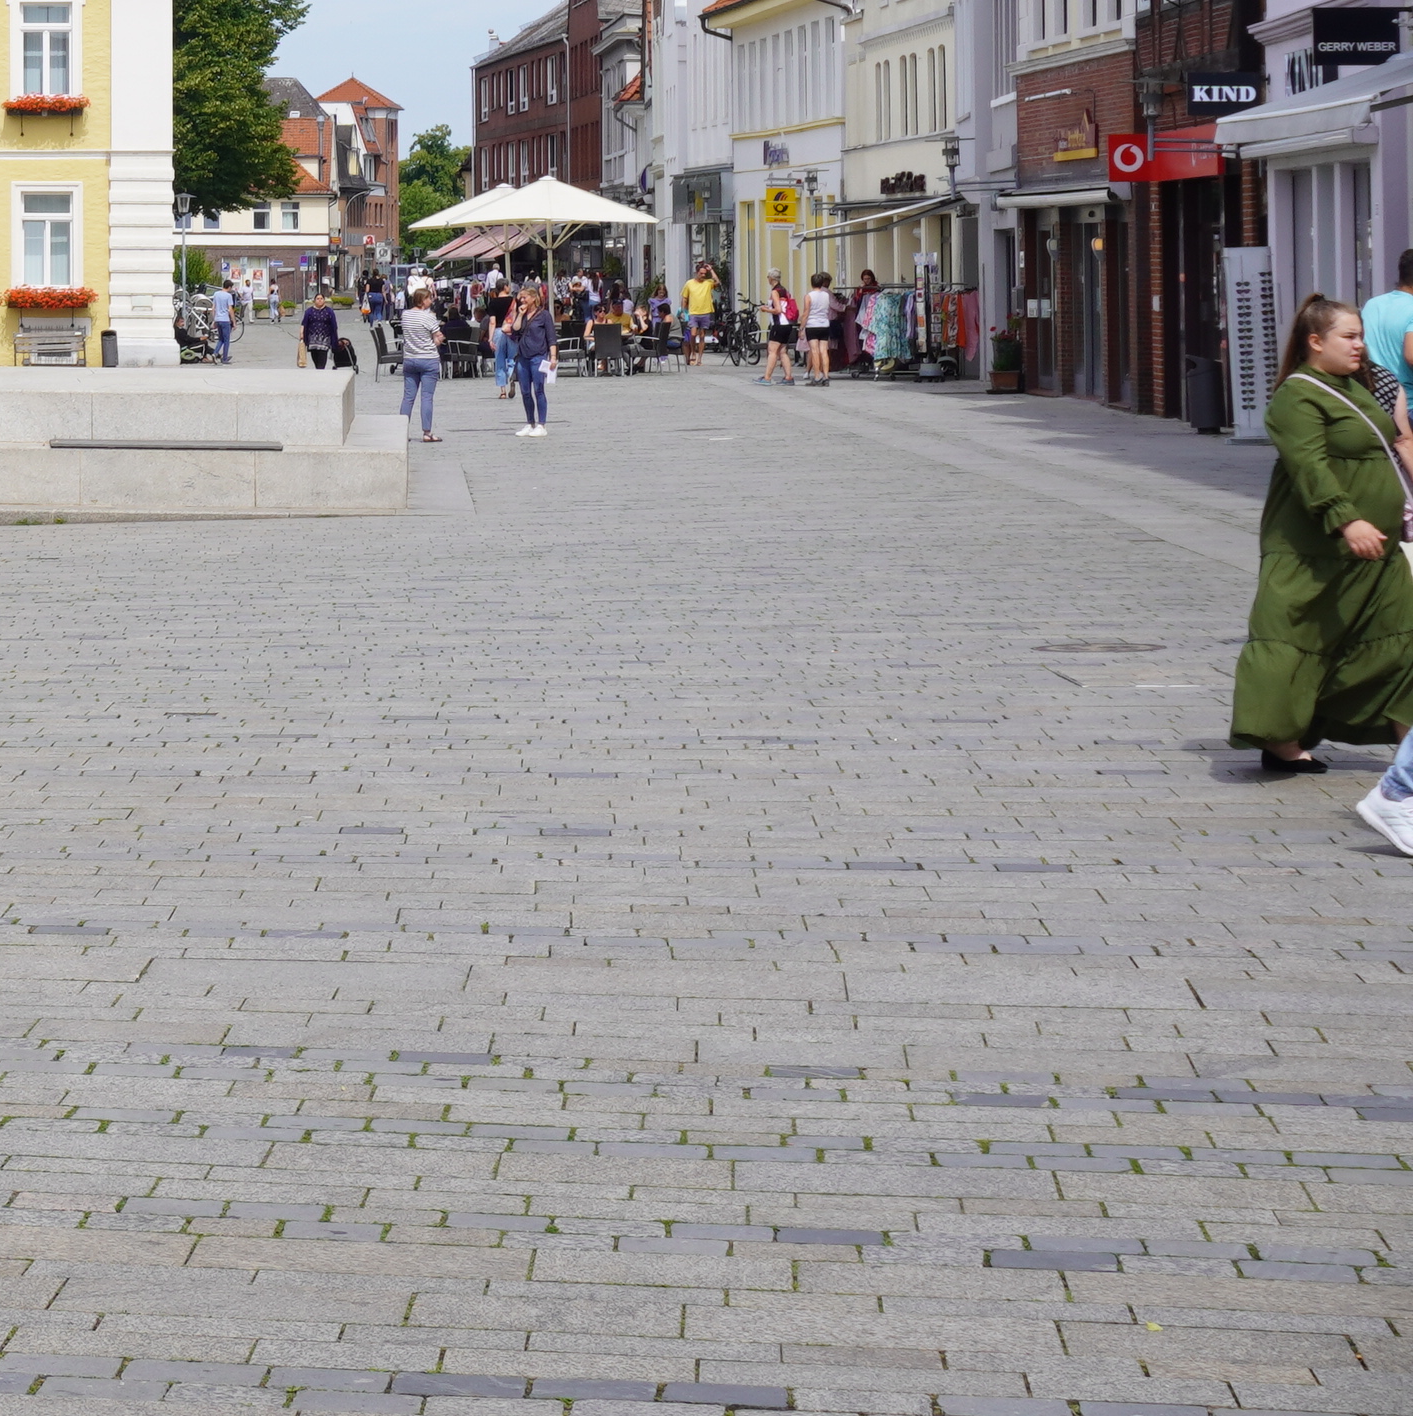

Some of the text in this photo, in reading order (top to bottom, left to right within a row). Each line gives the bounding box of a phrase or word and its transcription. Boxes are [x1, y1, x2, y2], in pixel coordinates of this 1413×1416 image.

[1317, 42, 1396, 52] GERRY WEBER
[1192, 85, 1257, 102] KIND
